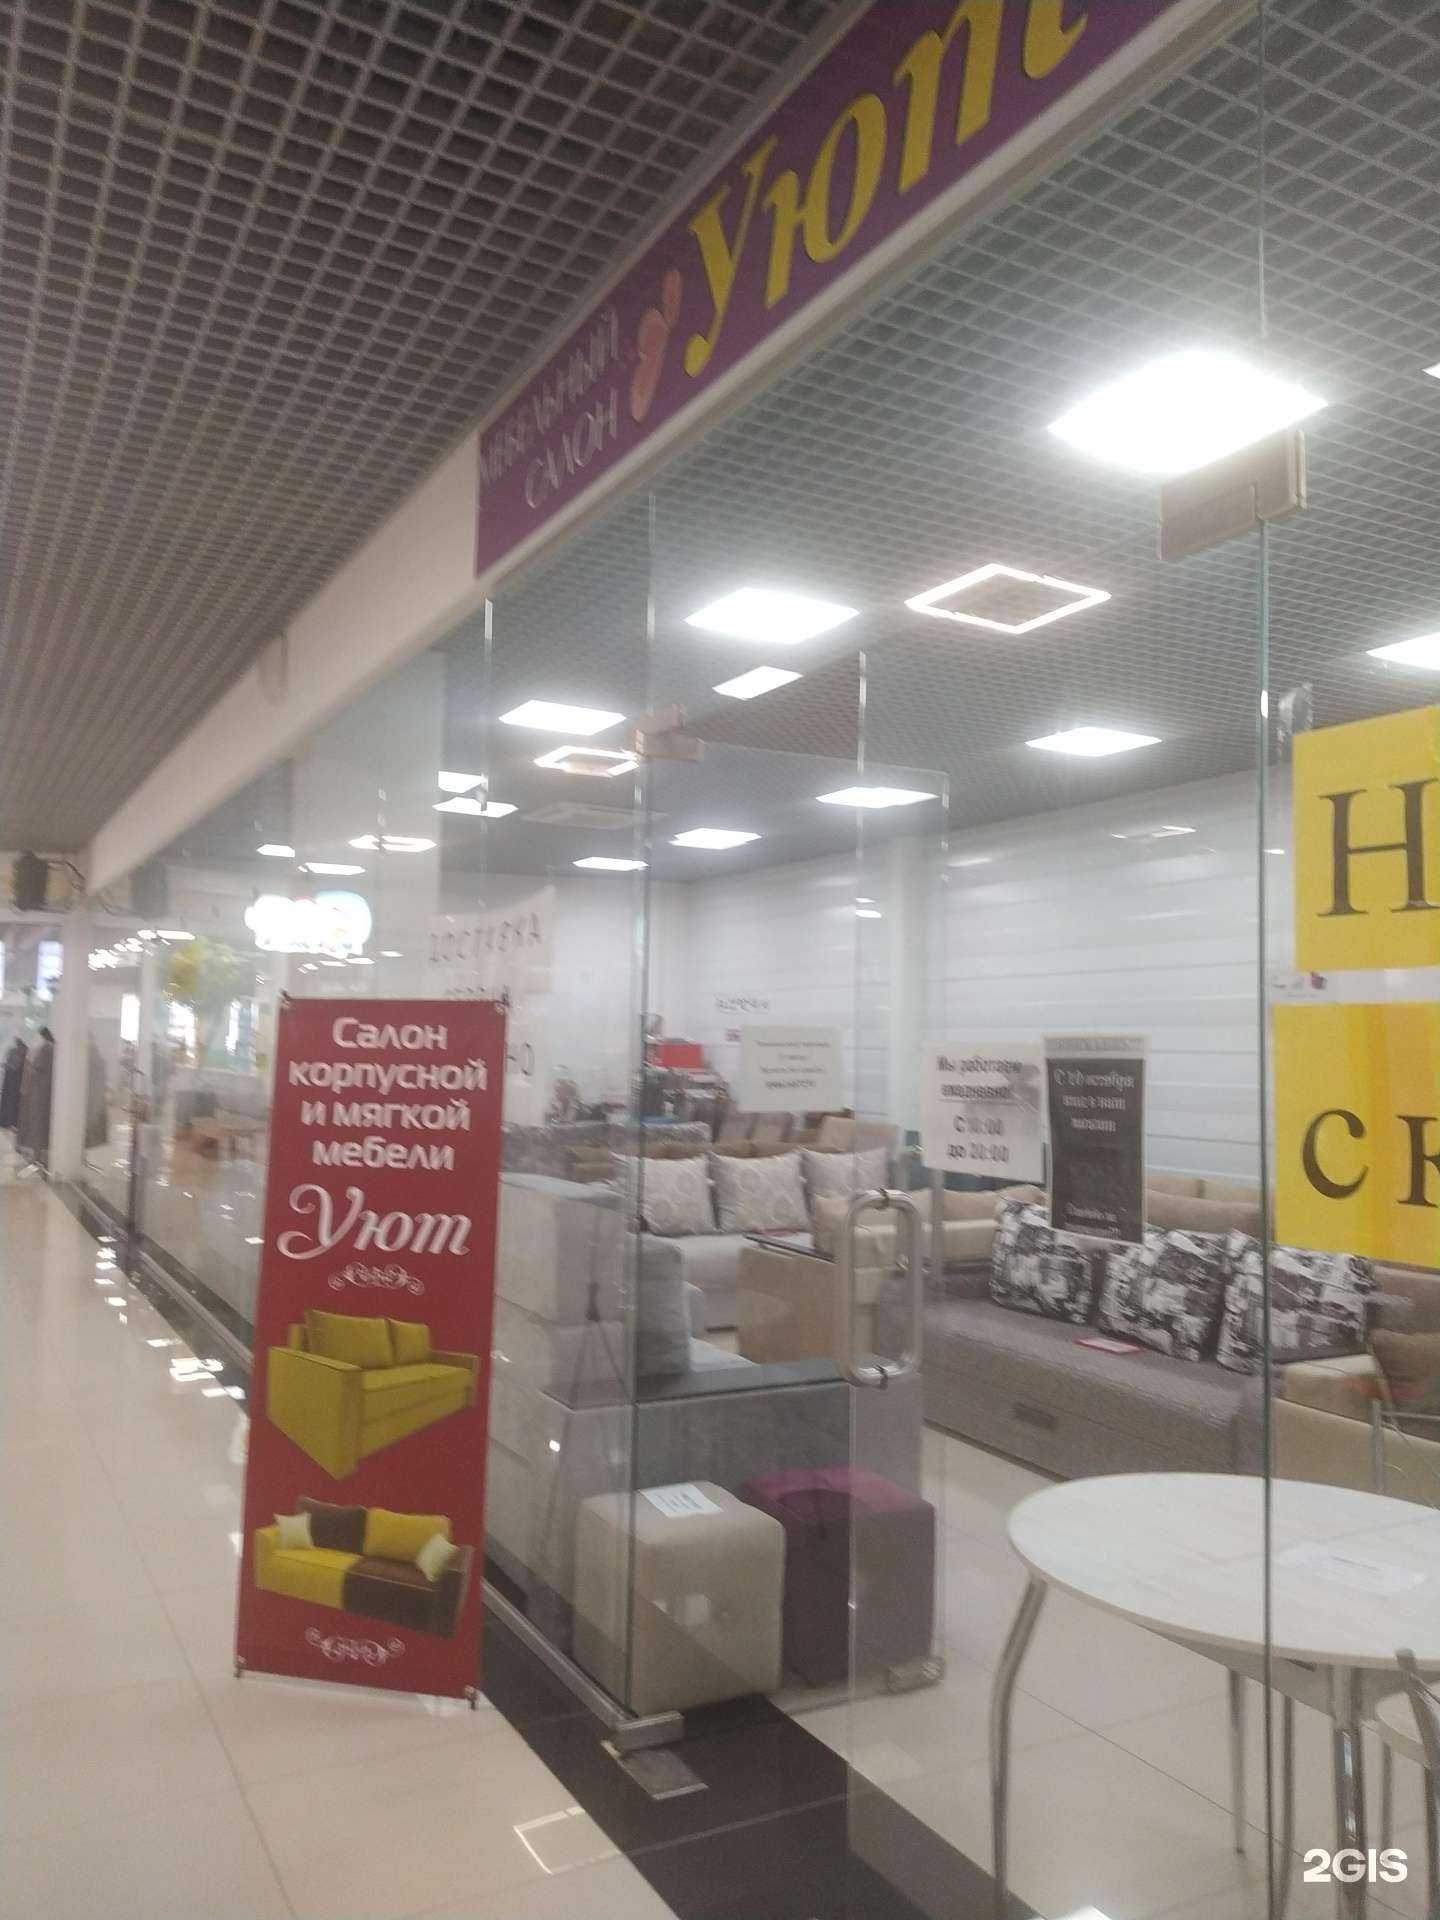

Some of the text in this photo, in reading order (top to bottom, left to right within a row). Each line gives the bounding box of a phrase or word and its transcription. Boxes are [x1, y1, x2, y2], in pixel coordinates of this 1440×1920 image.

[524, 386, 618, 509] САЛОН
[331, 1016, 448, 1051] Салон
[288, 1057, 488, 1096] корпусной
[332, 1098, 471, 1131] мягкой
[312, 1135, 455, 1170] мебели
[276, 1182, 473, 1261] Уют
